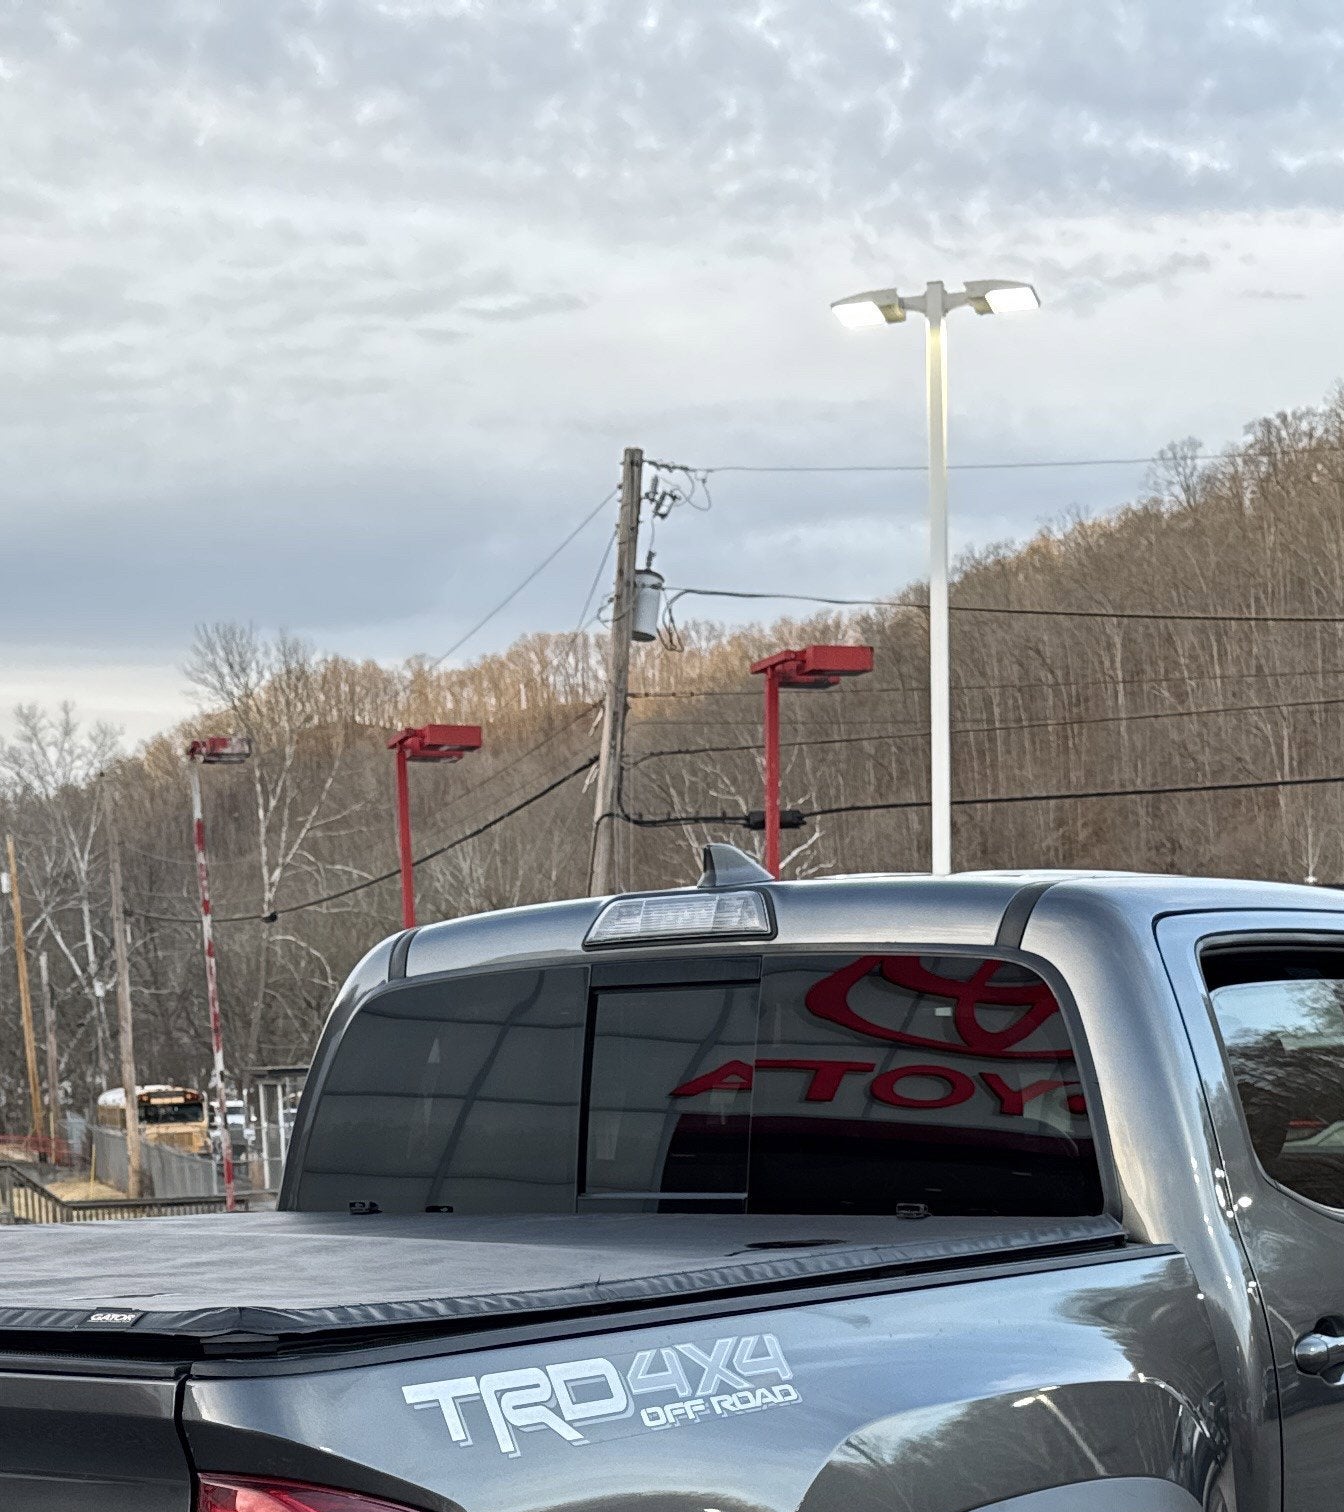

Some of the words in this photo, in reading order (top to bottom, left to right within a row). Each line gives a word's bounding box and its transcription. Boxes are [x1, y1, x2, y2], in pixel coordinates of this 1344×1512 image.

[401, 1357, 634, 1458] TRD
[639, 1398, 709, 1430] OFF
[709, 1383, 802, 1417] ROAD
